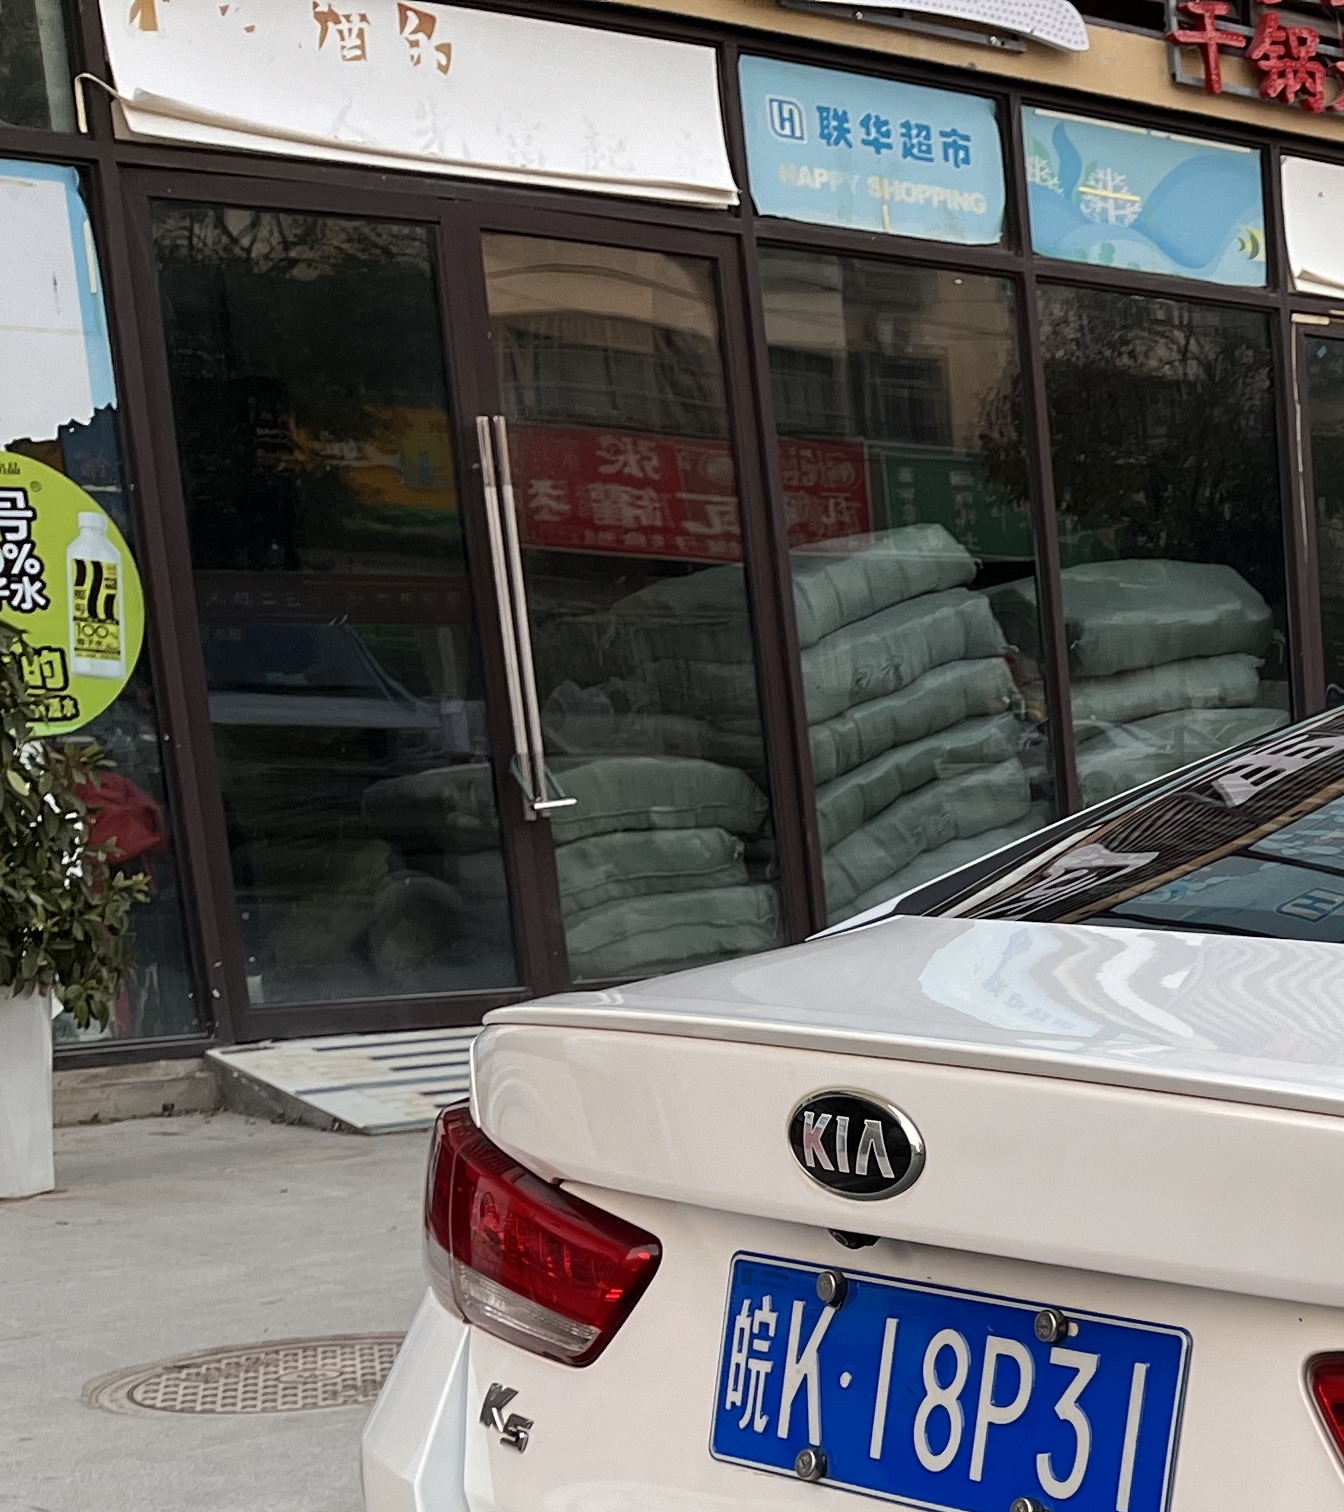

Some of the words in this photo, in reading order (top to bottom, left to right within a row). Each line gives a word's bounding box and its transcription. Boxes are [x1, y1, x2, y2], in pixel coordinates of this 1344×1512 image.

[816, 105, 971, 168] 联华超市
[866, 174, 988, 215] SHOPPING
[803, 1111, 895, 1179] KIA
[479, 1382, 535, 1454] K5
[725, 1295, 1151, 1512] 皖K·18P31
